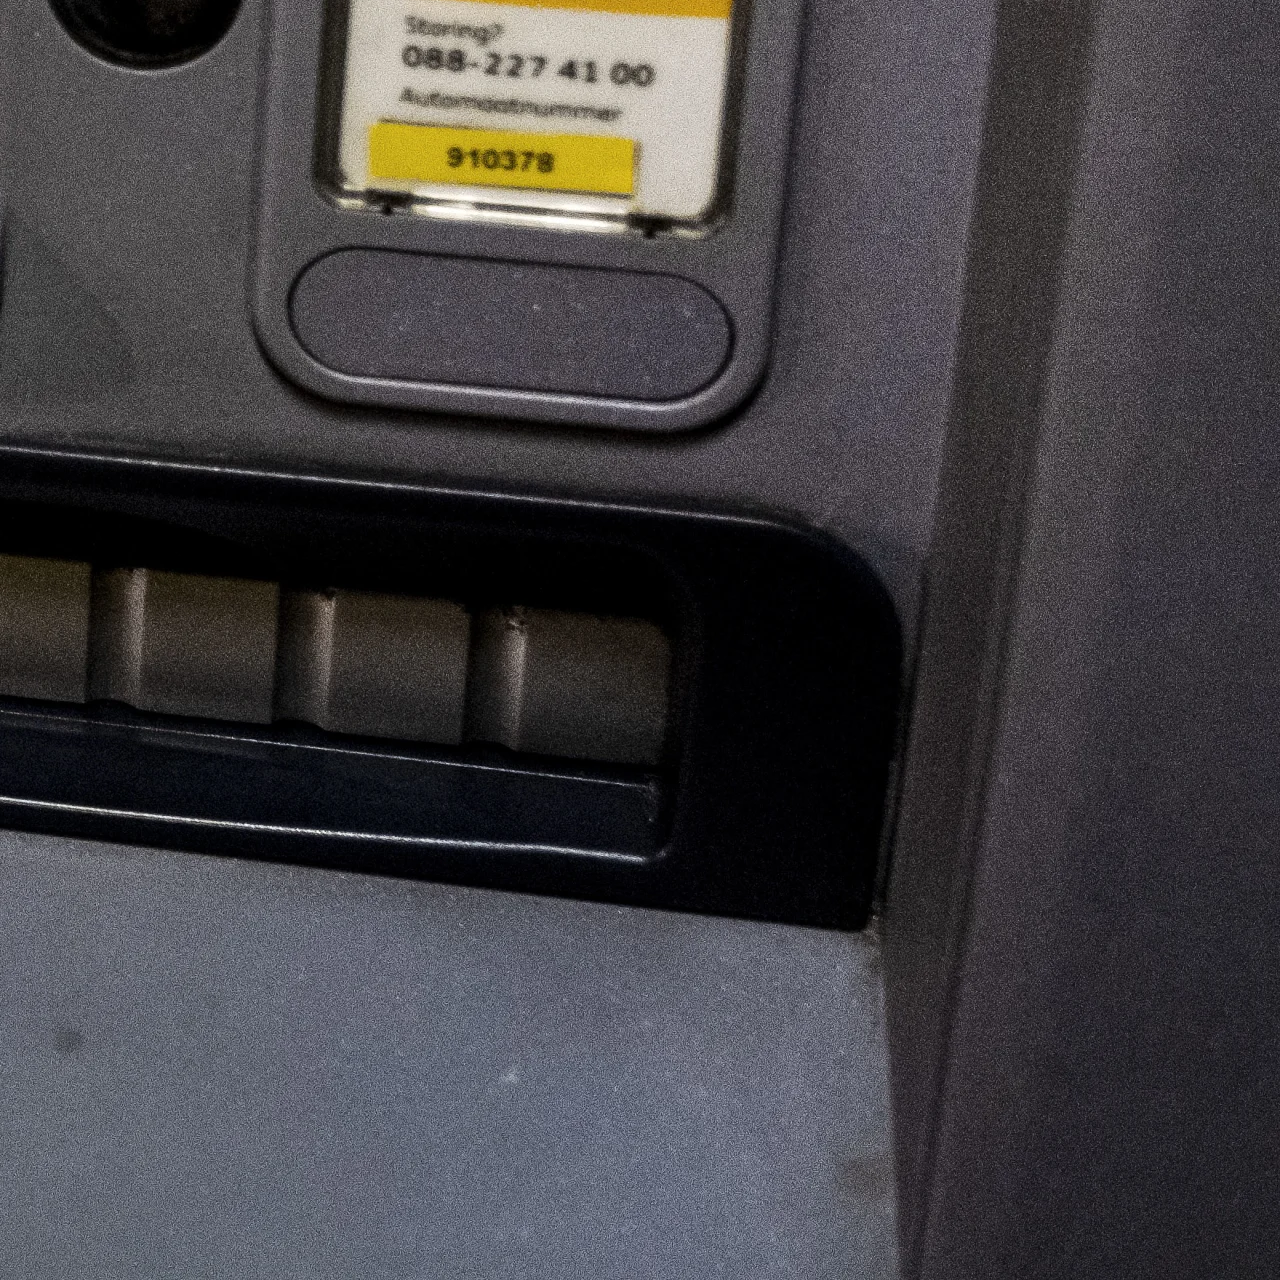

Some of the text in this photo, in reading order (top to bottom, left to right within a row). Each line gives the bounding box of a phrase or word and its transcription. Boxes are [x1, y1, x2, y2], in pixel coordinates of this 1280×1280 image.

[405, 15, 504, 45] Storing?
[402, 45, 656, 87] 088-227 41 00
[447, 146, 555, 173] 910378
